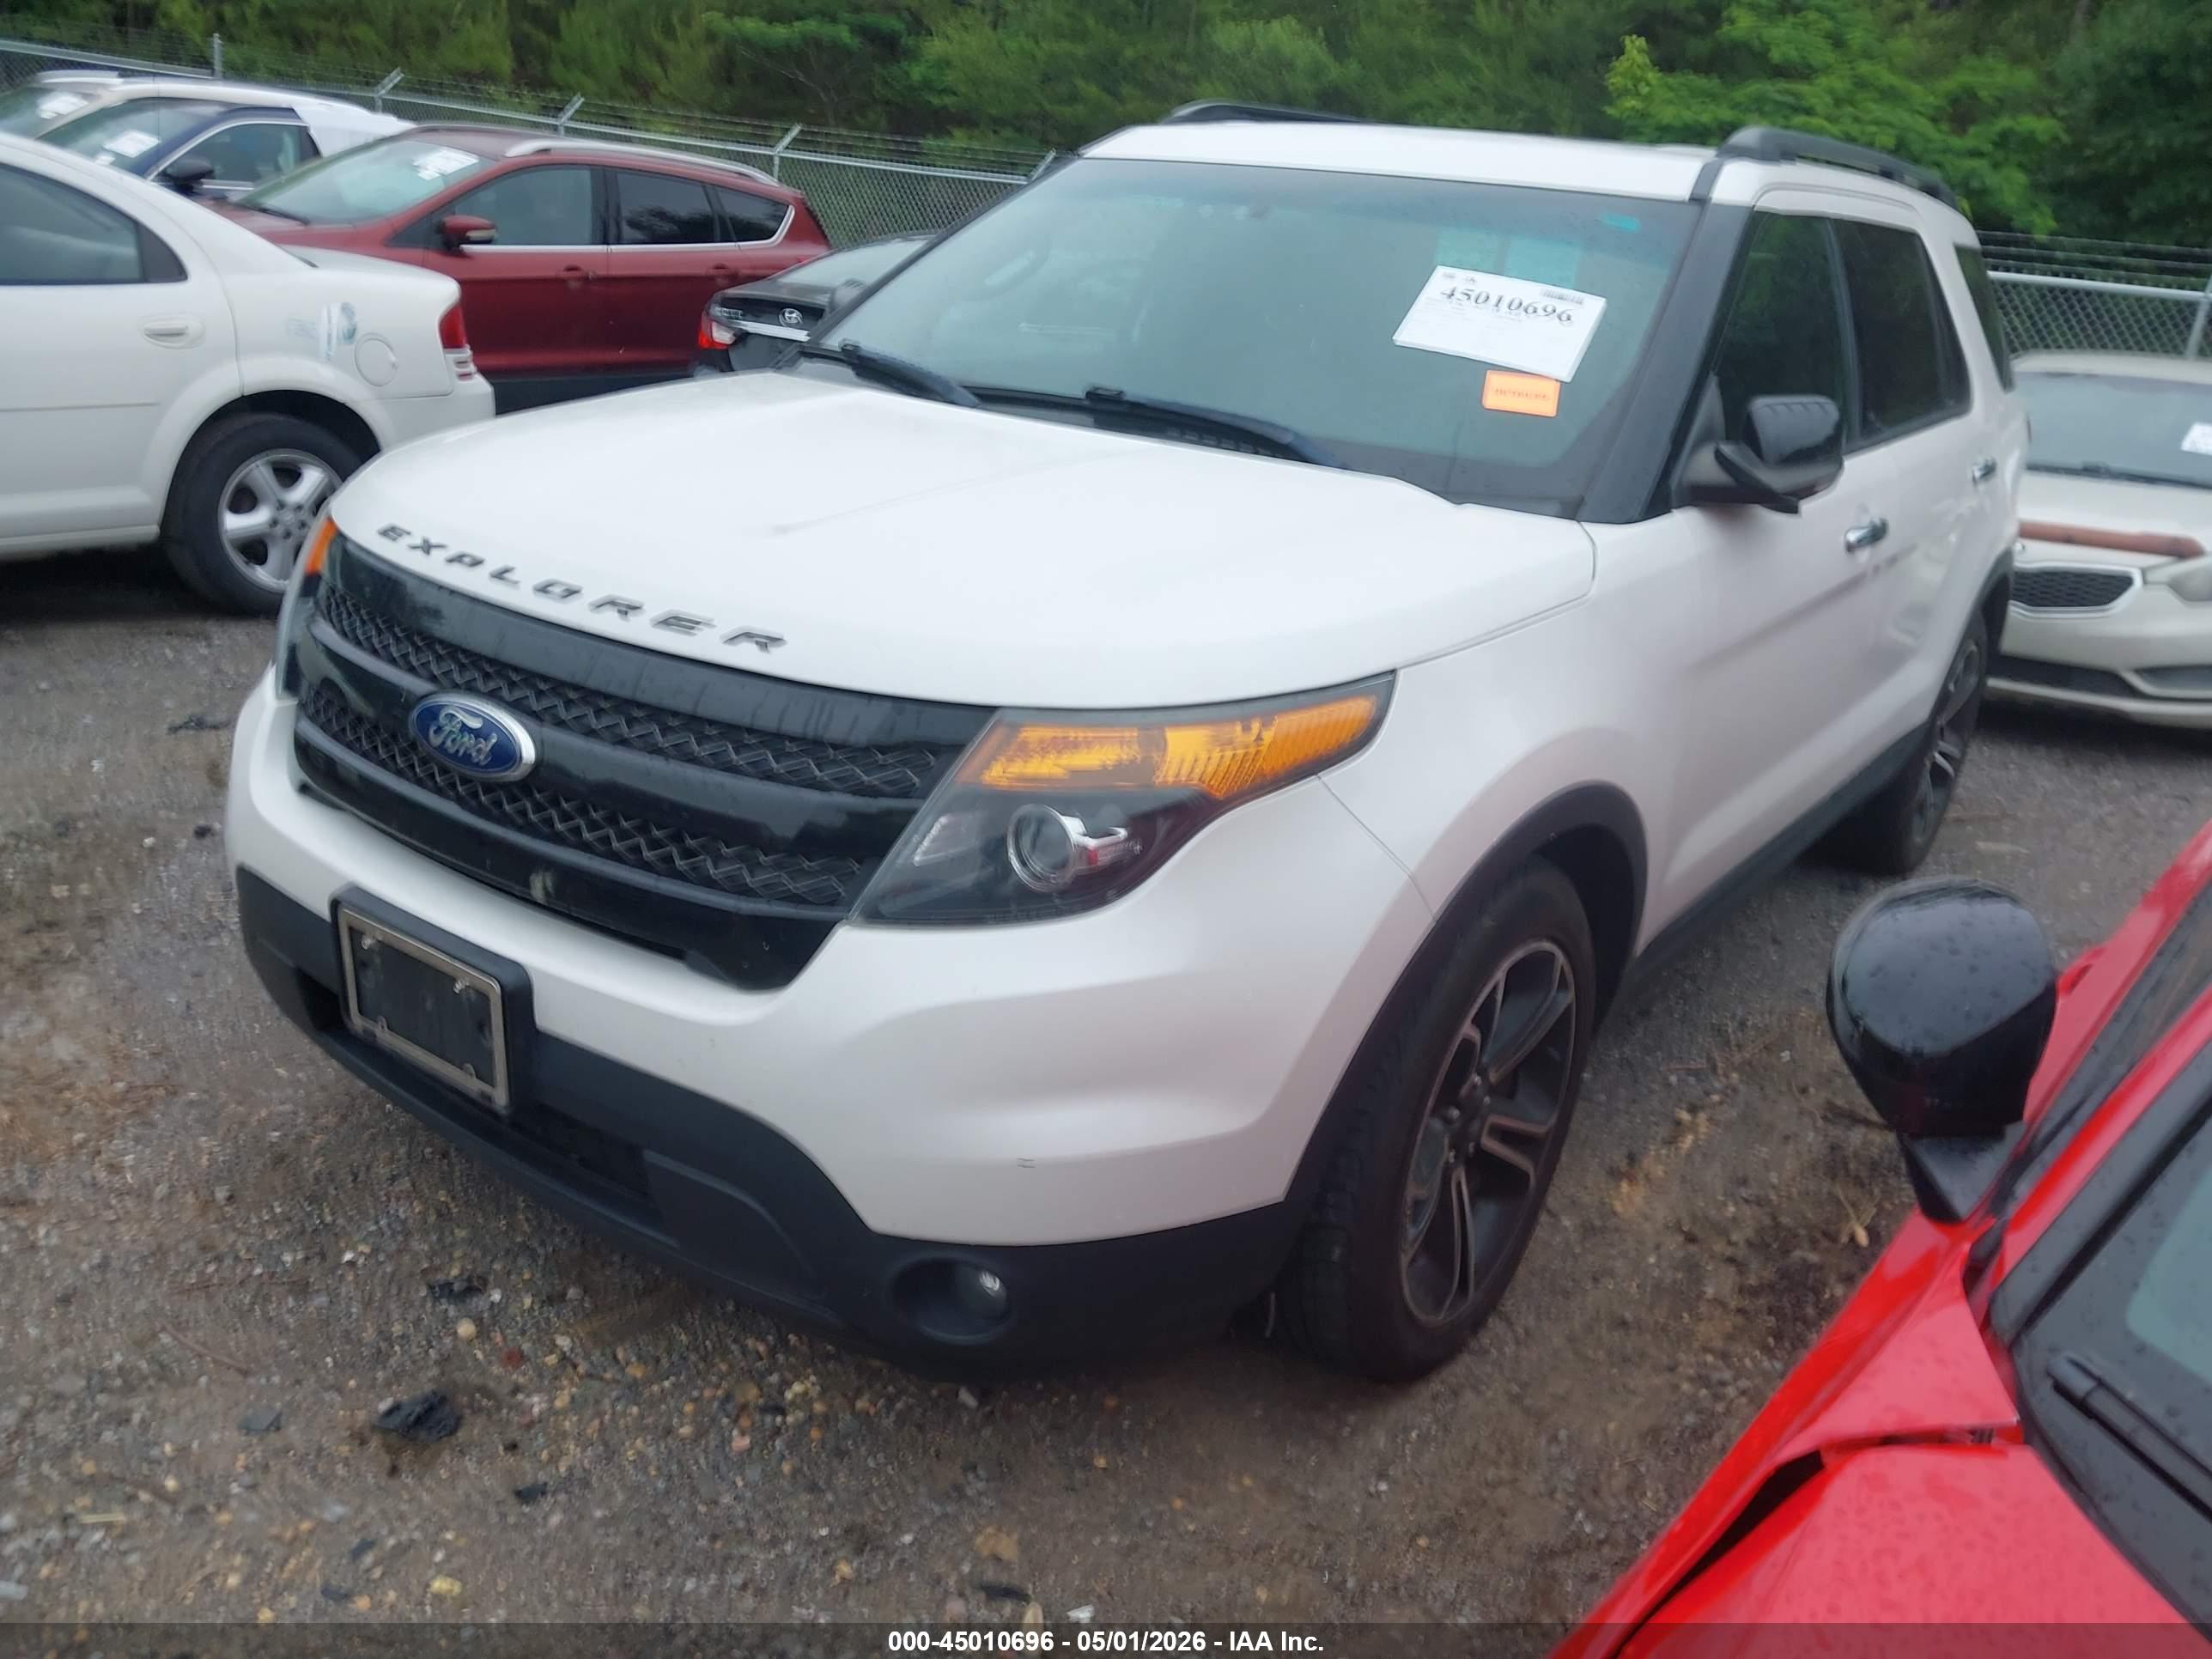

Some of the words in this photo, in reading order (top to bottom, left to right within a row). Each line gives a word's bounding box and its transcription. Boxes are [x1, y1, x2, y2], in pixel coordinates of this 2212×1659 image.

[1439, 285, 1576, 323] 45010696
[377, 523, 787, 653] EXPLORER
[428, 705, 499, 766] Ford
